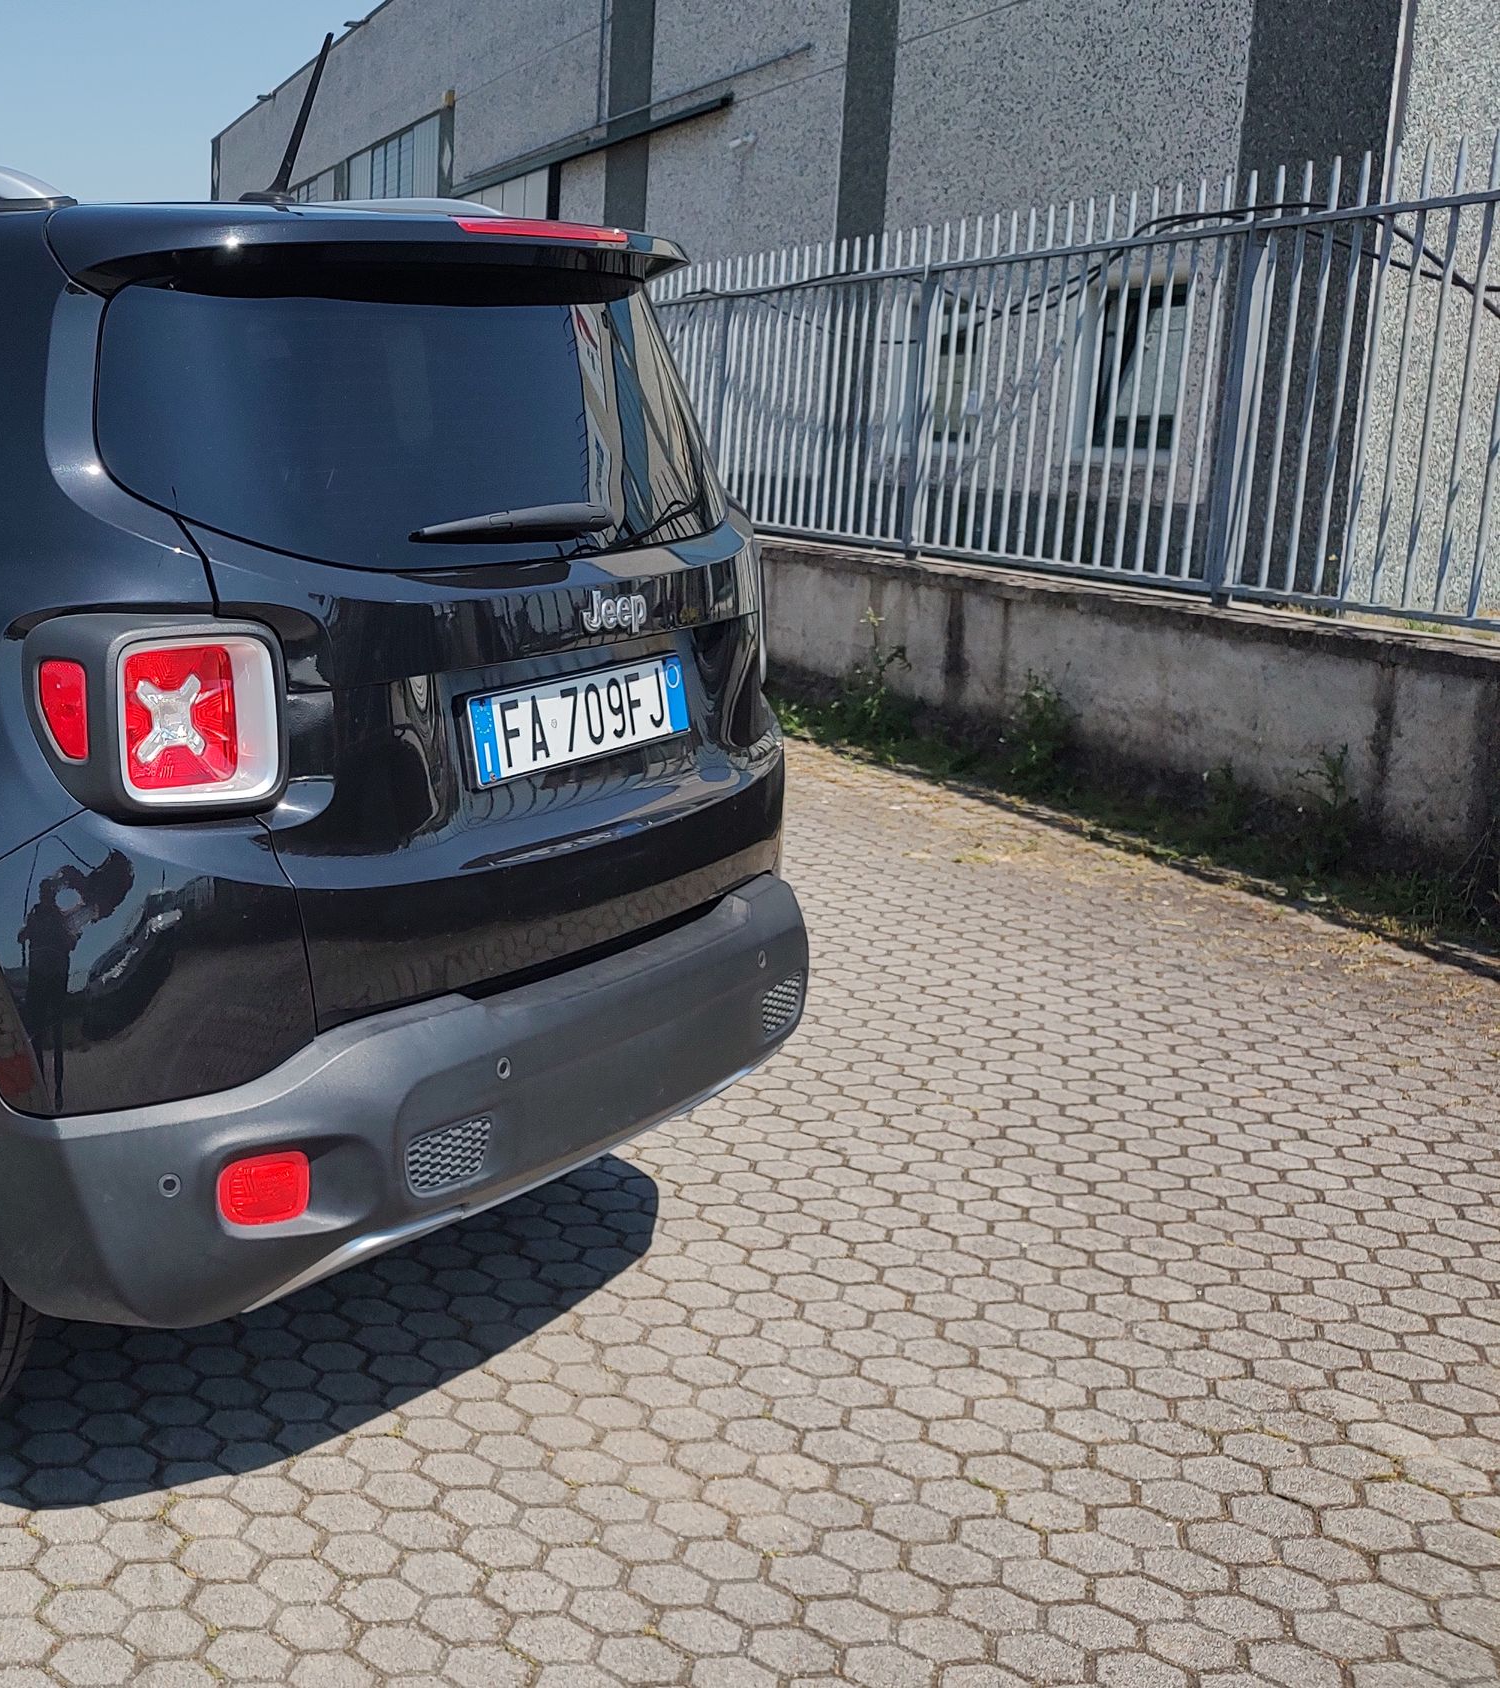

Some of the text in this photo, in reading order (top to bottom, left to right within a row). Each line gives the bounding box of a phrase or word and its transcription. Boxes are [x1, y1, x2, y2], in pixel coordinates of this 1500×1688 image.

[581, 590, 647, 633] Jeep
[499, 667, 665, 768] FA 709FJ
